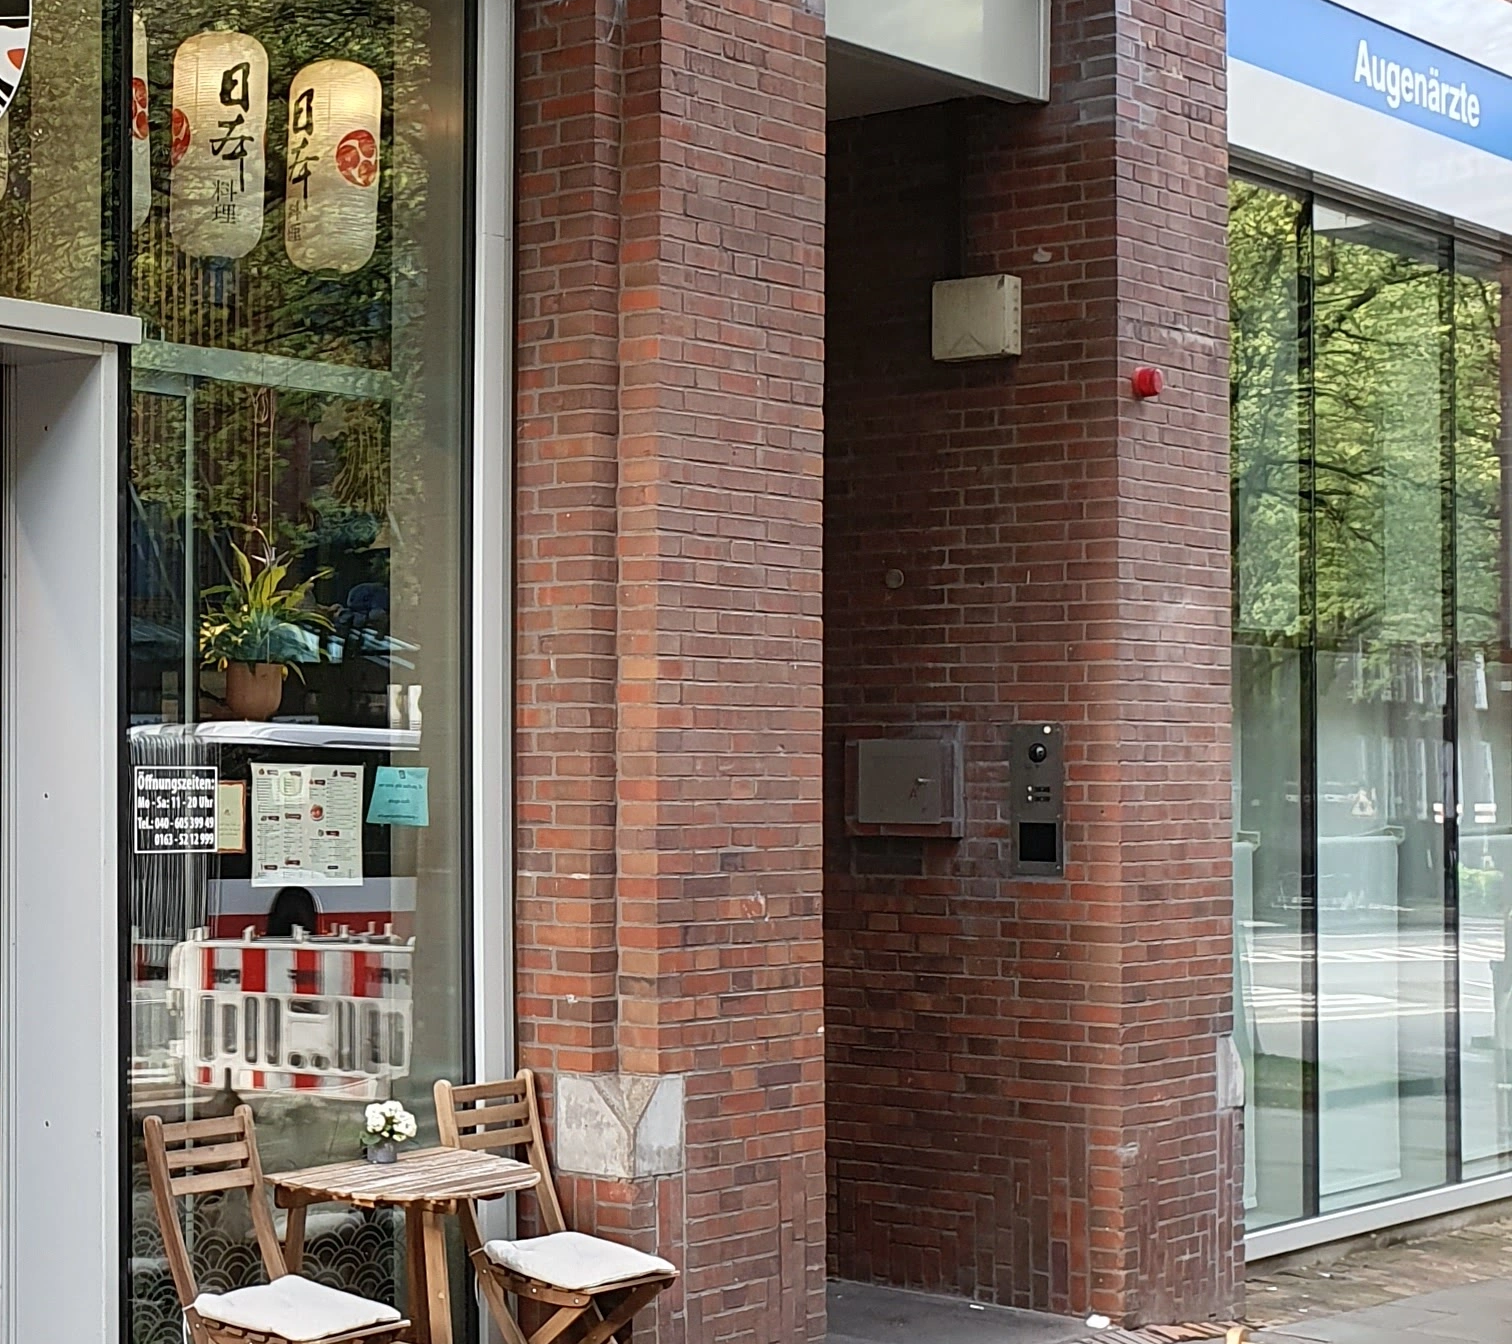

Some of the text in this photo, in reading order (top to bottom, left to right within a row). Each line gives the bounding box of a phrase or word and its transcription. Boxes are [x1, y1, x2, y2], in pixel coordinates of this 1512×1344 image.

[1354, 39, 1481, 128] Augenärzte
[138, 771, 215, 794] Öffnungszeiten:
[138, 796, 150, 808] Mo
[156, 796, 170, 808] Sa:
[171, 796, 180, 808] 11
[187, 796, 197, 808] 20
[198, 796, 213, 808] Uhr
[155, 817, 169, 829] 040
[174, 817, 188, 829] 605
[189, 817, 204, 829] 399
[205, 817, 214, 829] 49
[154, 833, 173, 846] 0163
[178, 833, 188, 845] 52
[190, 833, 199, 845] 12
[199, 833, 214, 845] 999
